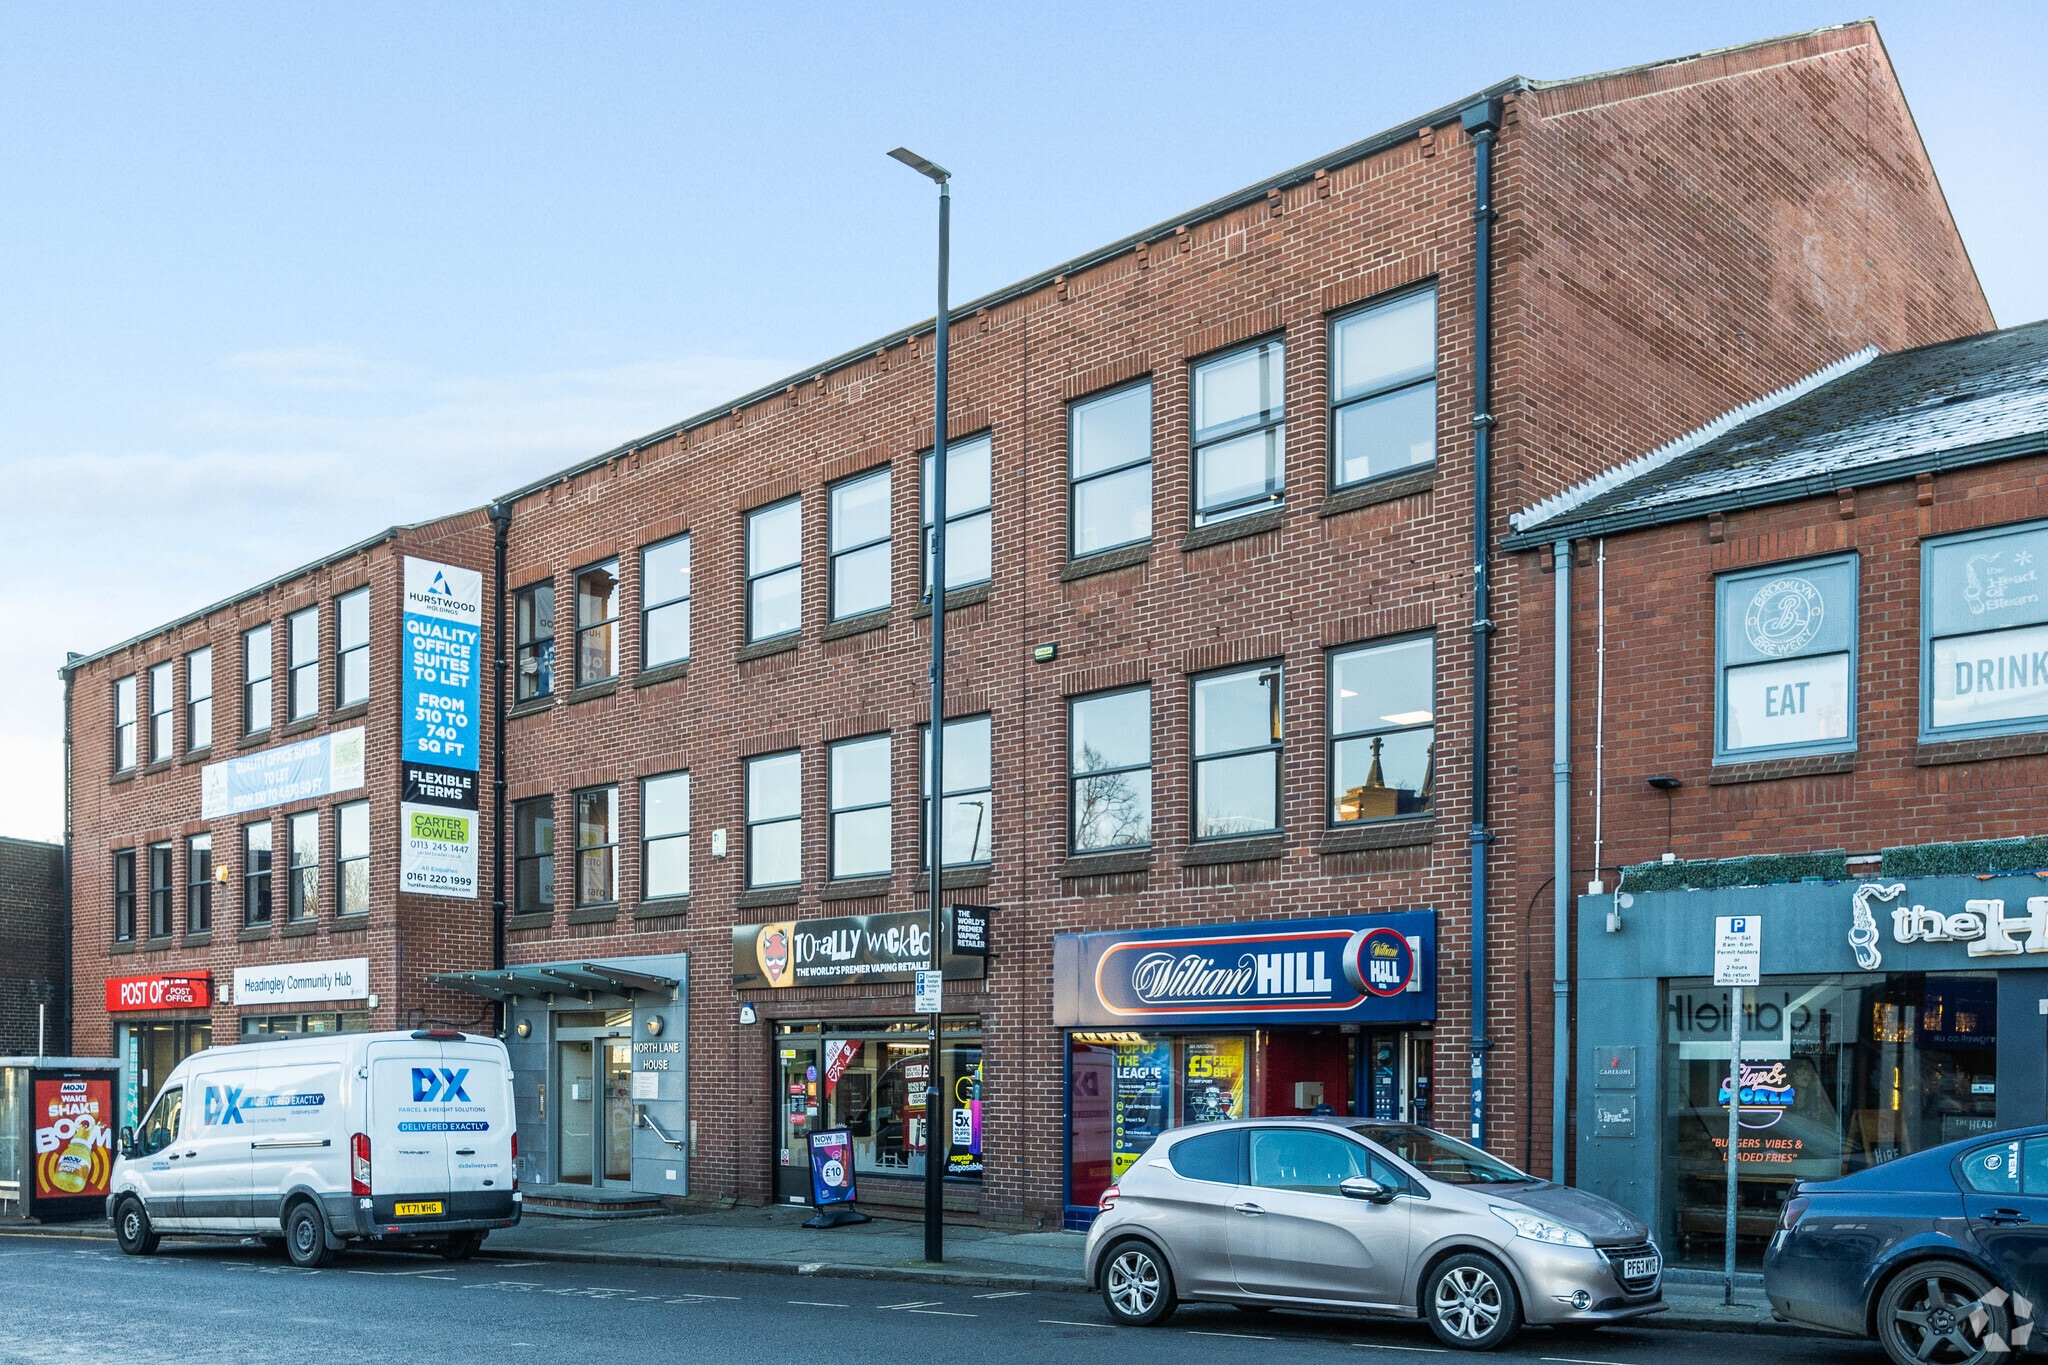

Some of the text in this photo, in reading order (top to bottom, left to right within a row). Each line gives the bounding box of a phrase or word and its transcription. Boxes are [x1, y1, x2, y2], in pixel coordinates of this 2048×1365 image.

[410, 592, 476, 612] HURSTWOOD
[1754, 581, 1815, 607] BROOKLYN
[427, 605, 458, 615] HOLDINGS
[407, 620, 477, 645] QUALITY
[413, 637, 471, 659] OFFICE
[1754, 628, 1811, 654] BREWERY
[414, 652, 470, 673] SUITES
[414, 666, 470, 688] TO LET
[1955, 651, 2048, 695] DRINK
[419, 692, 464, 713] FROM
[1765, 681, 1810, 718] EAT
[415, 707, 468, 727] 310 TO
[426, 724, 457, 740] 740
[418, 738, 465, 756] SQ FT
[410, 770, 472, 789] FLEXIBLE
[418, 784, 463, 800] TERMS
[415, 816, 461, 830] CARTER
[416, 826, 465, 841] TOWLER
[410, 840, 469, 854] 0113 245 1447
[407, 872, 472, 886] 0161 220 1999
[958, 918, 985, 926] WORLD'S
[958, 925, 983, 934] PREMIER
[1734, 920, 1744, 932] P
[1891, 905, 1985, 944] the
[958, 932, 980, 940] VAPING
[958, 940, 985, 948] RETAILER
[1370, 940, 1399, 958] William
[796, 968, 810, 977] THE
[810, 966, 840, 976] WORLD'S
[841, 965, 870, 975] PREMIER
[871, 963, 898, 973] VAPING
[1132, 951, 1332, 1000] William HILL
[1370, 960, 1400, 983] HILL
[244, 978, 286, 994] Headingley
[287, 974, 332, 992] Community
[334, 971, 352, 987] Hub
[121, 981, 148, 1005] POST
[165, 994, 193, 1003] OFFICE
[634, 1043, 679, 1053] NORTH LANE
[1118, 1042, 1157, 1054] TOP OF
[644, 1060, 669, 1070] HOUSE
[1117, 1056, 1140, 1067] THE
[1188, 1055, 1239, 1077] £5 FREE
[1117, 1068, 1162, 1079] LEAGUE
[1214, 1067, 1234, 1078] BET
[412, 1068, 472, 1102] DX
[61, 1095, 87, 1103] WAKE
[204, 1084, 244, 1125] DX
[1719, 1088, 1795, 1105] PCKLE
[48, 1102, 99, 1117] SHAKE
[402, 1123, 448, 1131] DELIVERED
[1969, 1120, 1992, 1131] HEAD
[36, 1114, 112, 1154] BOOM
[1712, 1138, 1803, 1149] "BUGERS VIBES &
[1723, 1152, 1763, 1162] LADED
[825, 1167, 842, 1177] £10
[949, 1163, 983, 1172] disposable
[2008, 1152, 2018, 1179] TEIN
[401, 1203, 437, 1214] YT71 WHG
[1628, 1260, 1645, 1276] PF63
